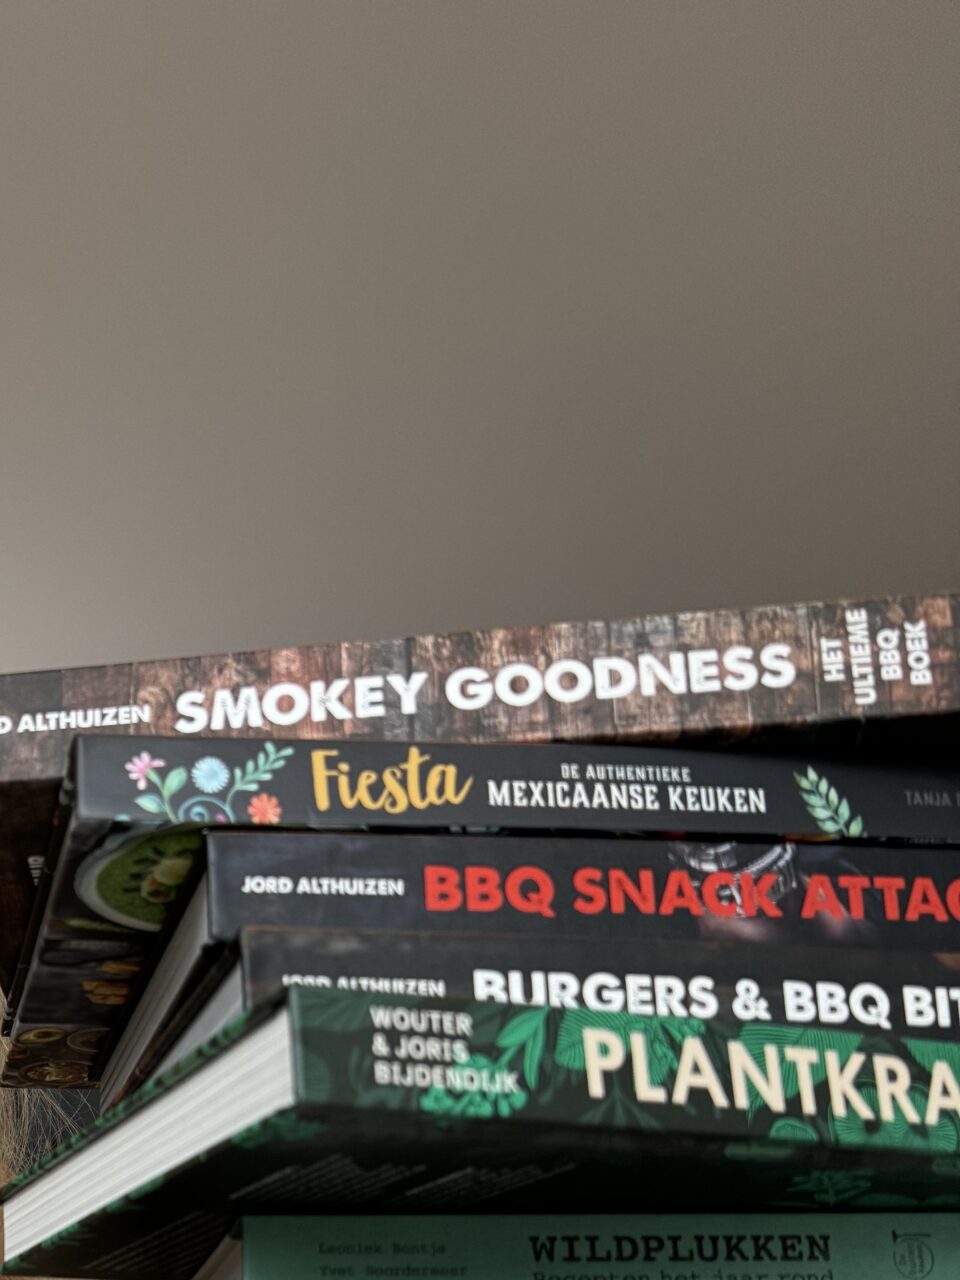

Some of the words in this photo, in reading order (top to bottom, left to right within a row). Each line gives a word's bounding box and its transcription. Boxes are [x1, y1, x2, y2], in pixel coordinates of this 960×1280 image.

[820, 637, 845, 682] HET
[845, 608, 877, 705] ULTIEME
[877, 627, 902, 681] BBQ
[904, 620, 933, 686] BOEK
[175, 672, 428, 733] SMOKEY
[445, 643, 796, 710] GOODNESS
[17, 705, 150, 734] ALTHUIZEN
[311, 746, 473, 814] Fiesta
[561, 763, 582, 779] DE
[586, 764, 690, 783] AUTHENTIEKE
[487, 779, 660, 811] MEXICAANSE
[669, 785, 766, 814] KEUKEN
[241, 875, 293, 895] JORD
[297, 877, 405, 897] ALTHUIZEN
[424, 865, 555, 918] BBQ
[572, 867, 783, 918] SNACK
[369, 1005, 474, 1037] WOUTER
[473, 968, 720, 1019] BURGERS
[732, 978, 772, 1020] &
[783, 980, 891, 1029] BBQ
[372, 1032, 390, 1057] &
[395, 1035, 471, 1065] JORIS
[373, 1059, 522, 1095] BIJDENDIJK
[582, 1027, 960, 1126] PLANTKRA
[530, 1235, 831, 1263] WILDPLUKKEN
